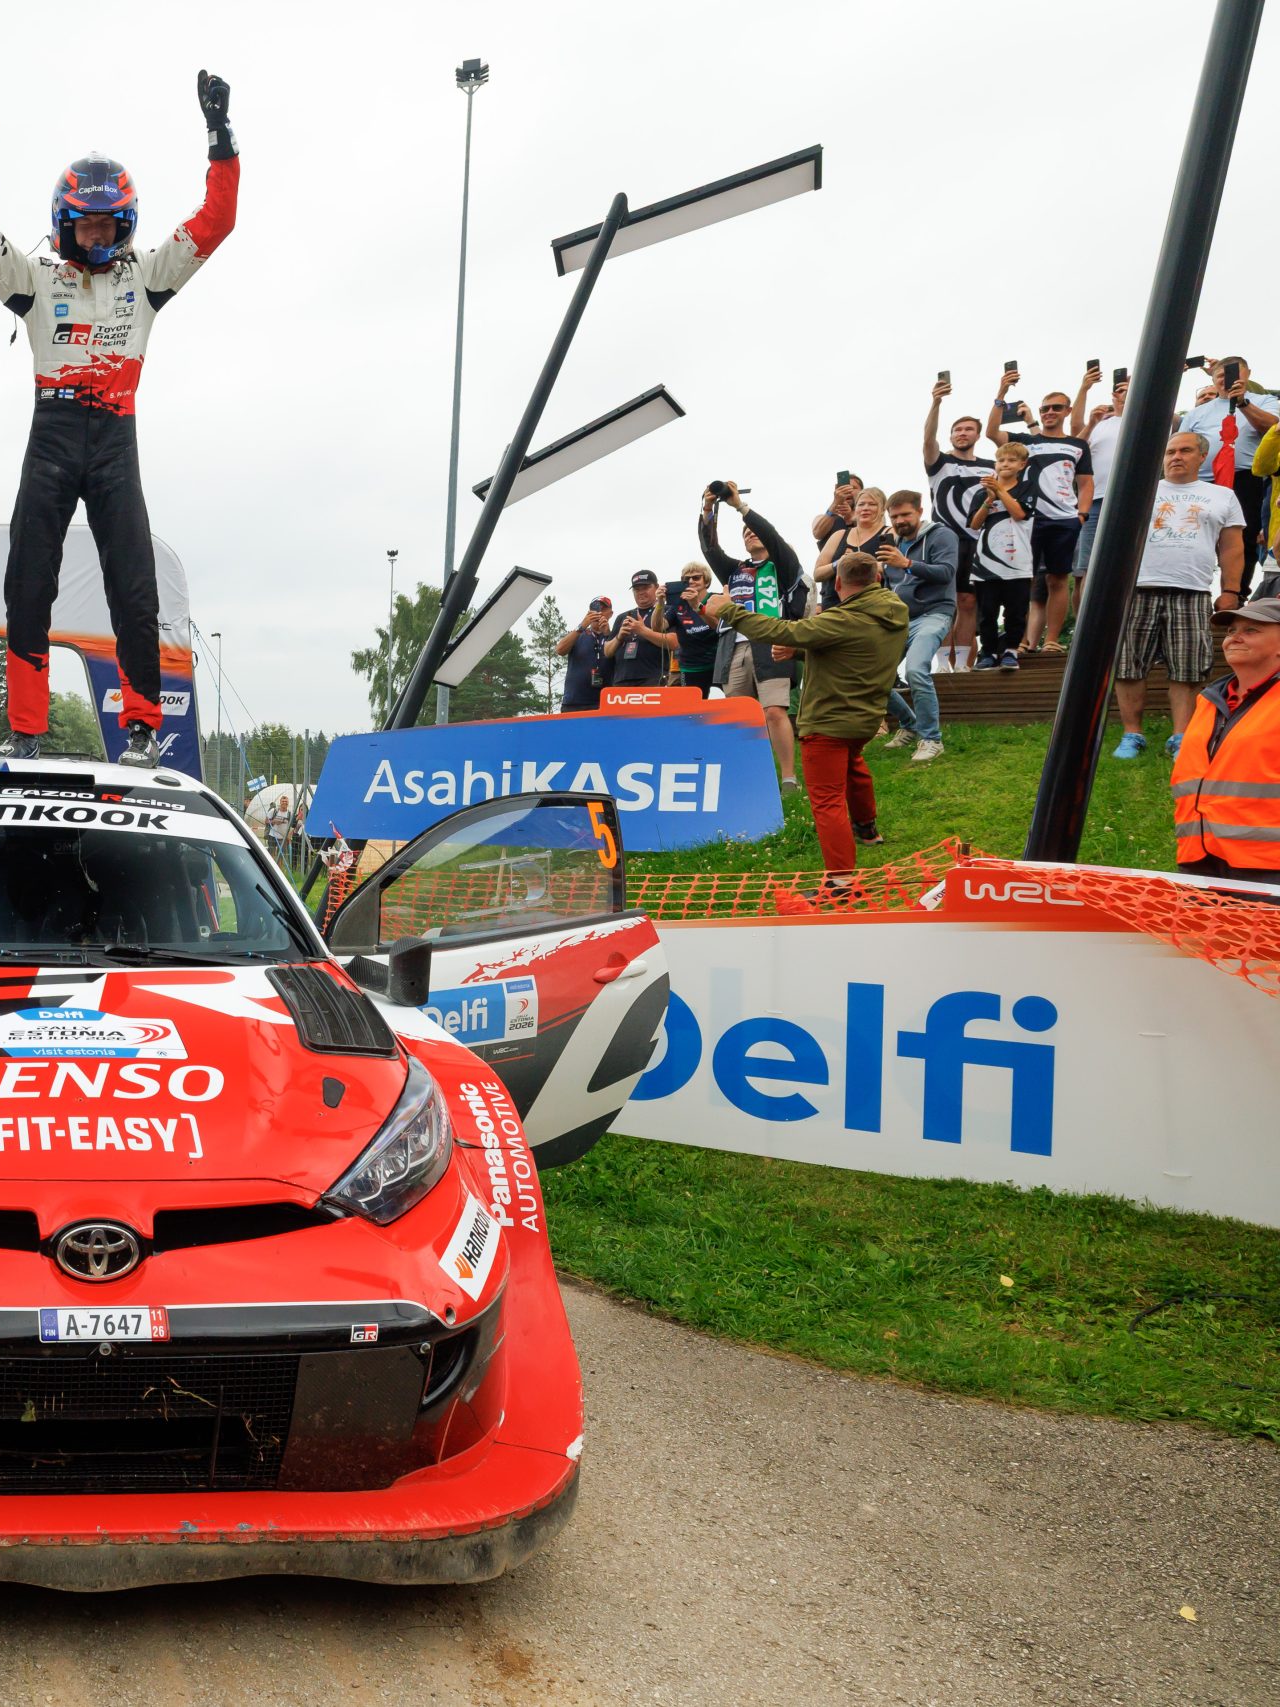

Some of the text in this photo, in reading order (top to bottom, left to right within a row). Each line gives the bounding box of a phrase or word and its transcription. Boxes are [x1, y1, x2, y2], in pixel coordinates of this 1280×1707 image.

[78, 185, 117, 194] Capital Box
[53, 327, 90, 345] GR
[758, 575, 777, 609] 243
[606, 693, 661, 705] WRC
[102, 793, 186, 811] Racing
[586, 802, 617, 869] 5
[964, 879, 1085, 906] WRC
[38, 1009, 84, 1019] Delfi
[422, 997, 488, 1034] Delfi
[509, 1021, 534, 1031] 2026
[33, 1048, 64, 1056] visit
[65, 1048, 116, 1056] estonia
[460, 1082, 515, 1227] Panasonic
[480, 1081, 540, 1233] AUTOMOTIVE
[151, 1310, 163, 1321] 11
[45, 1313, 143, 1337] FIN A-7647
[152, 1325, 165, 1338] 26
[353, 1328, 377, 1341] GR
